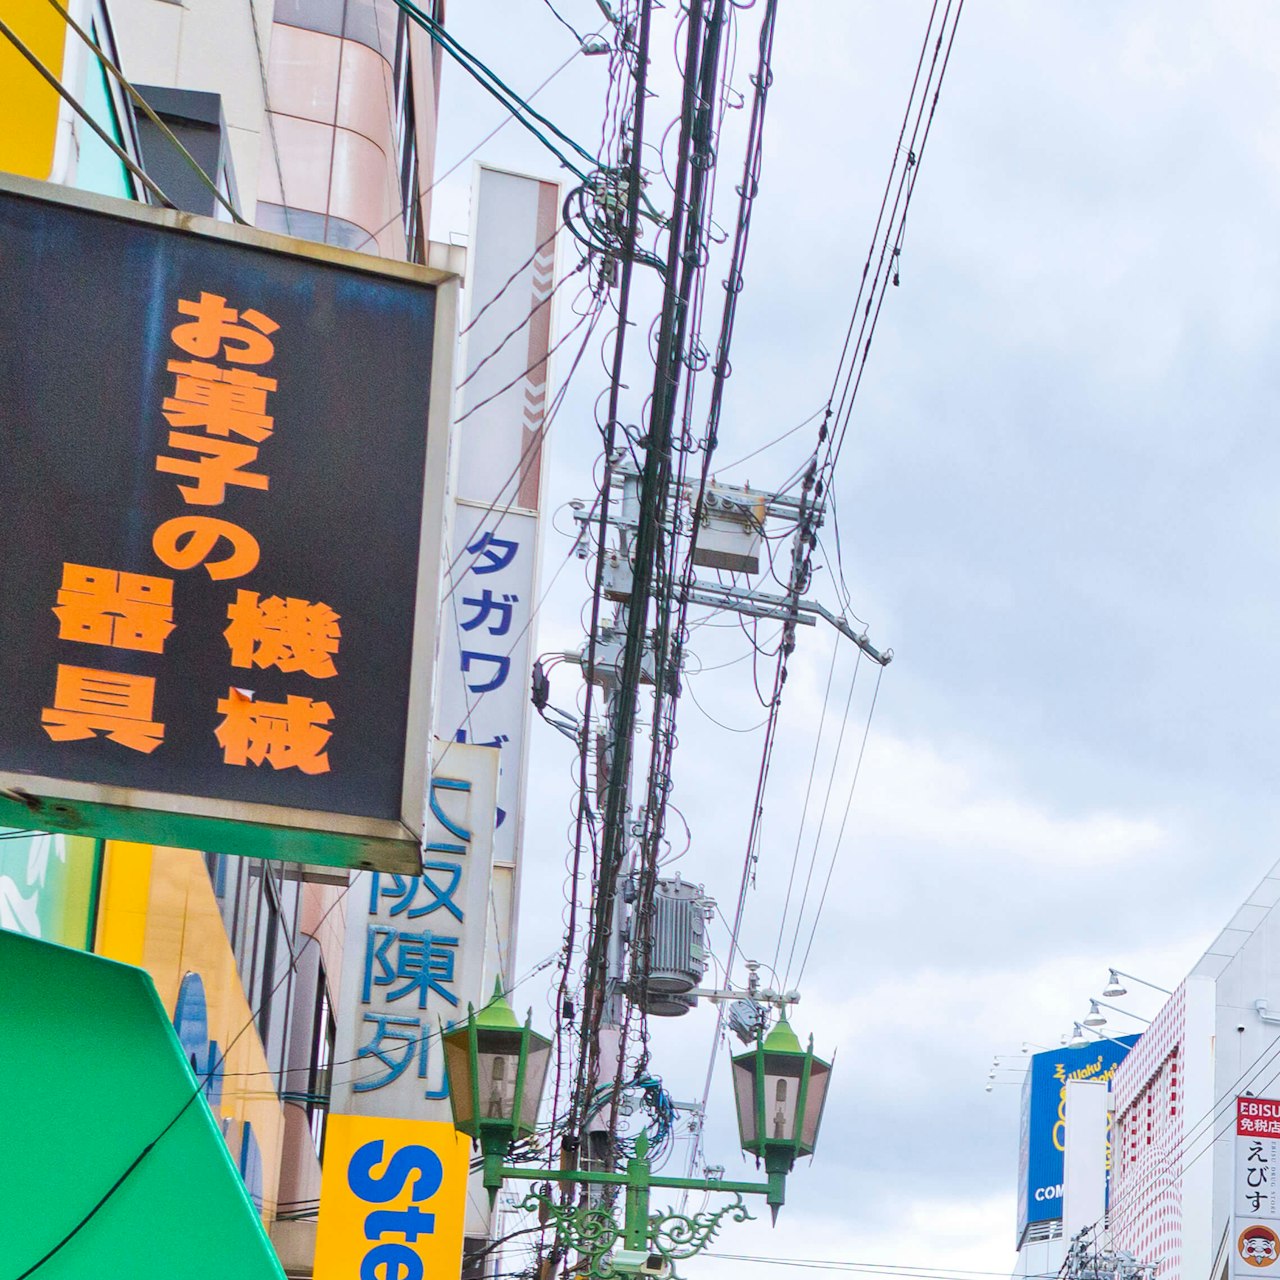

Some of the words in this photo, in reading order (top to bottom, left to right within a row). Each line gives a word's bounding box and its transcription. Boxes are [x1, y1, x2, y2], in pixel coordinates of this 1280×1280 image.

[152, 291, 281, 582] お菓子の
[41, 562, 175, 754] 器具
[215, 590, 341, 776] 機械
[1246, 1141, 1268, 1213] えびす
